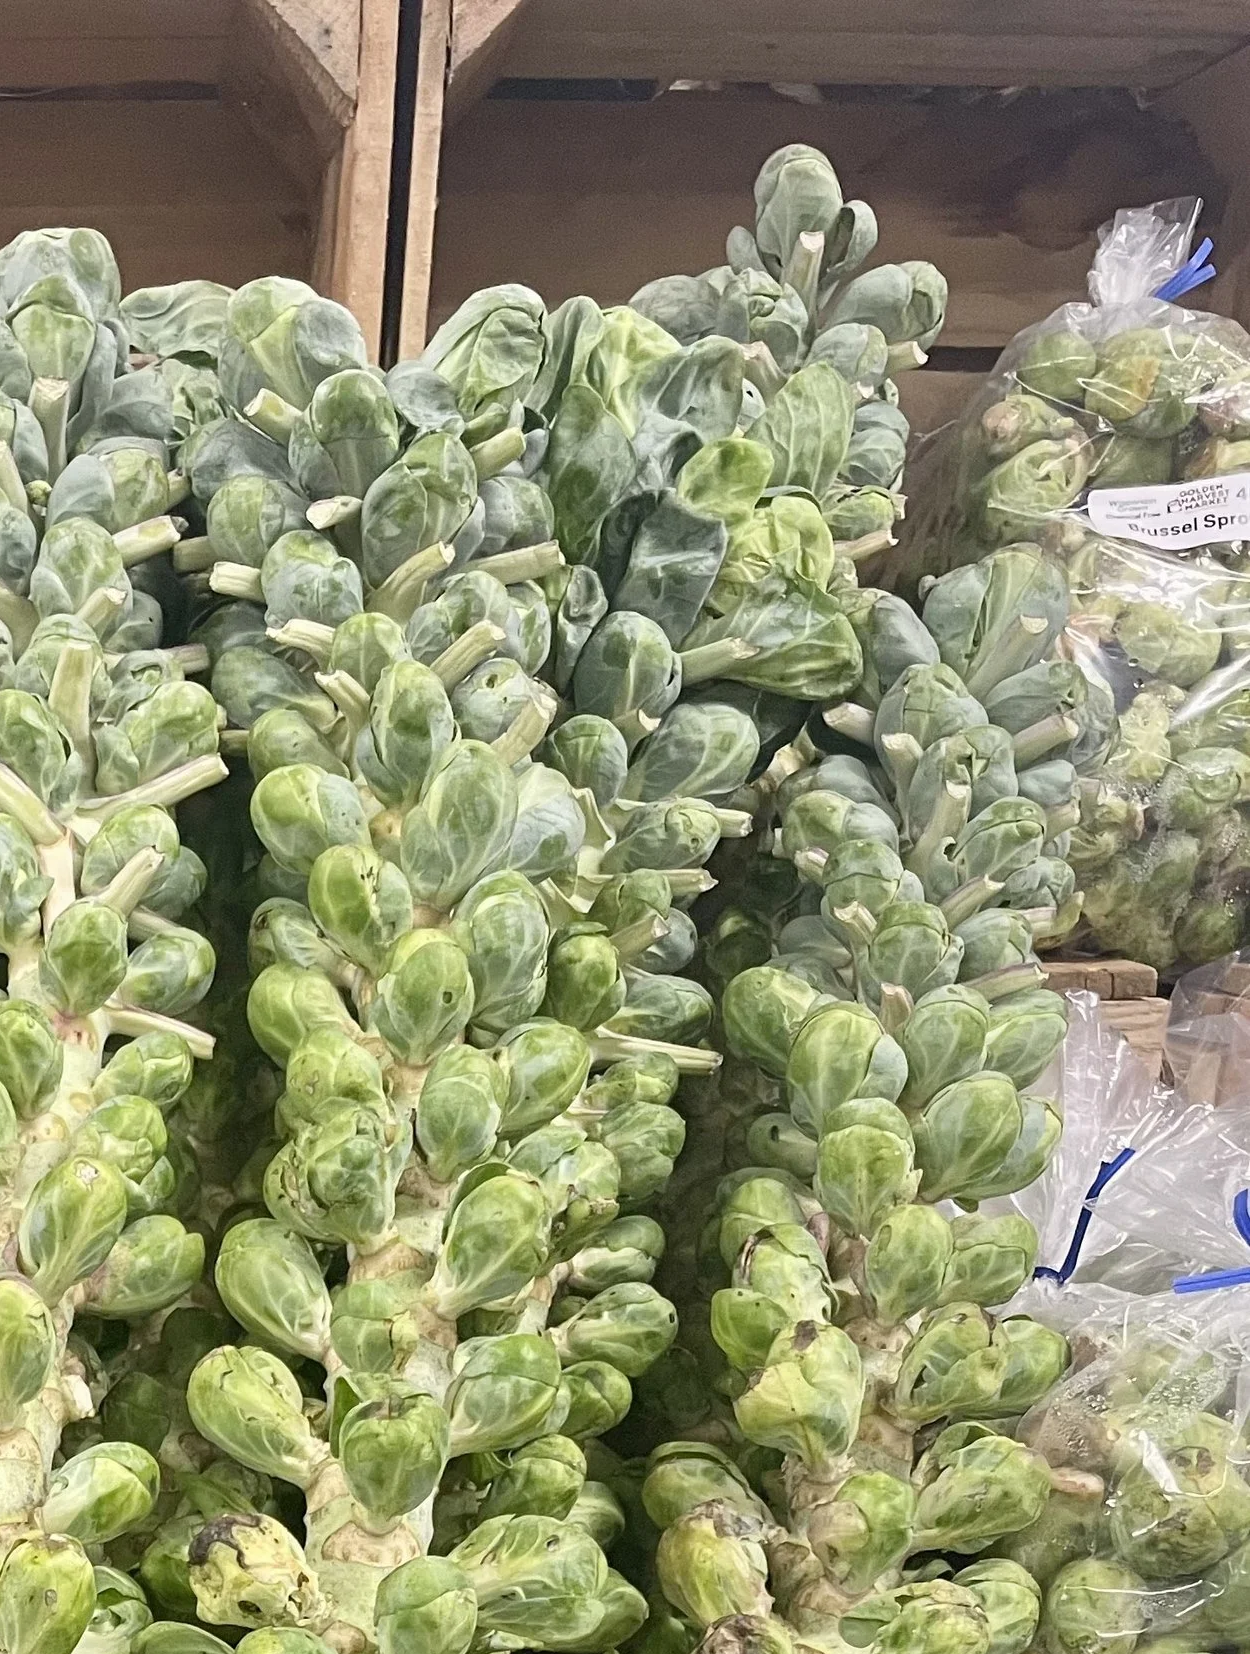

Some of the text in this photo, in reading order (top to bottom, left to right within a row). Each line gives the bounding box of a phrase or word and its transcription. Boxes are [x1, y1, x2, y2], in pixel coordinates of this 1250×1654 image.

[1179, 484, 1223, 498] GOLDEN
[1181, 488, 1230, 504] HARVEST
[1185, 497, 1228, 511] MARKET
[1203, 514, 1248, 530] Spro
